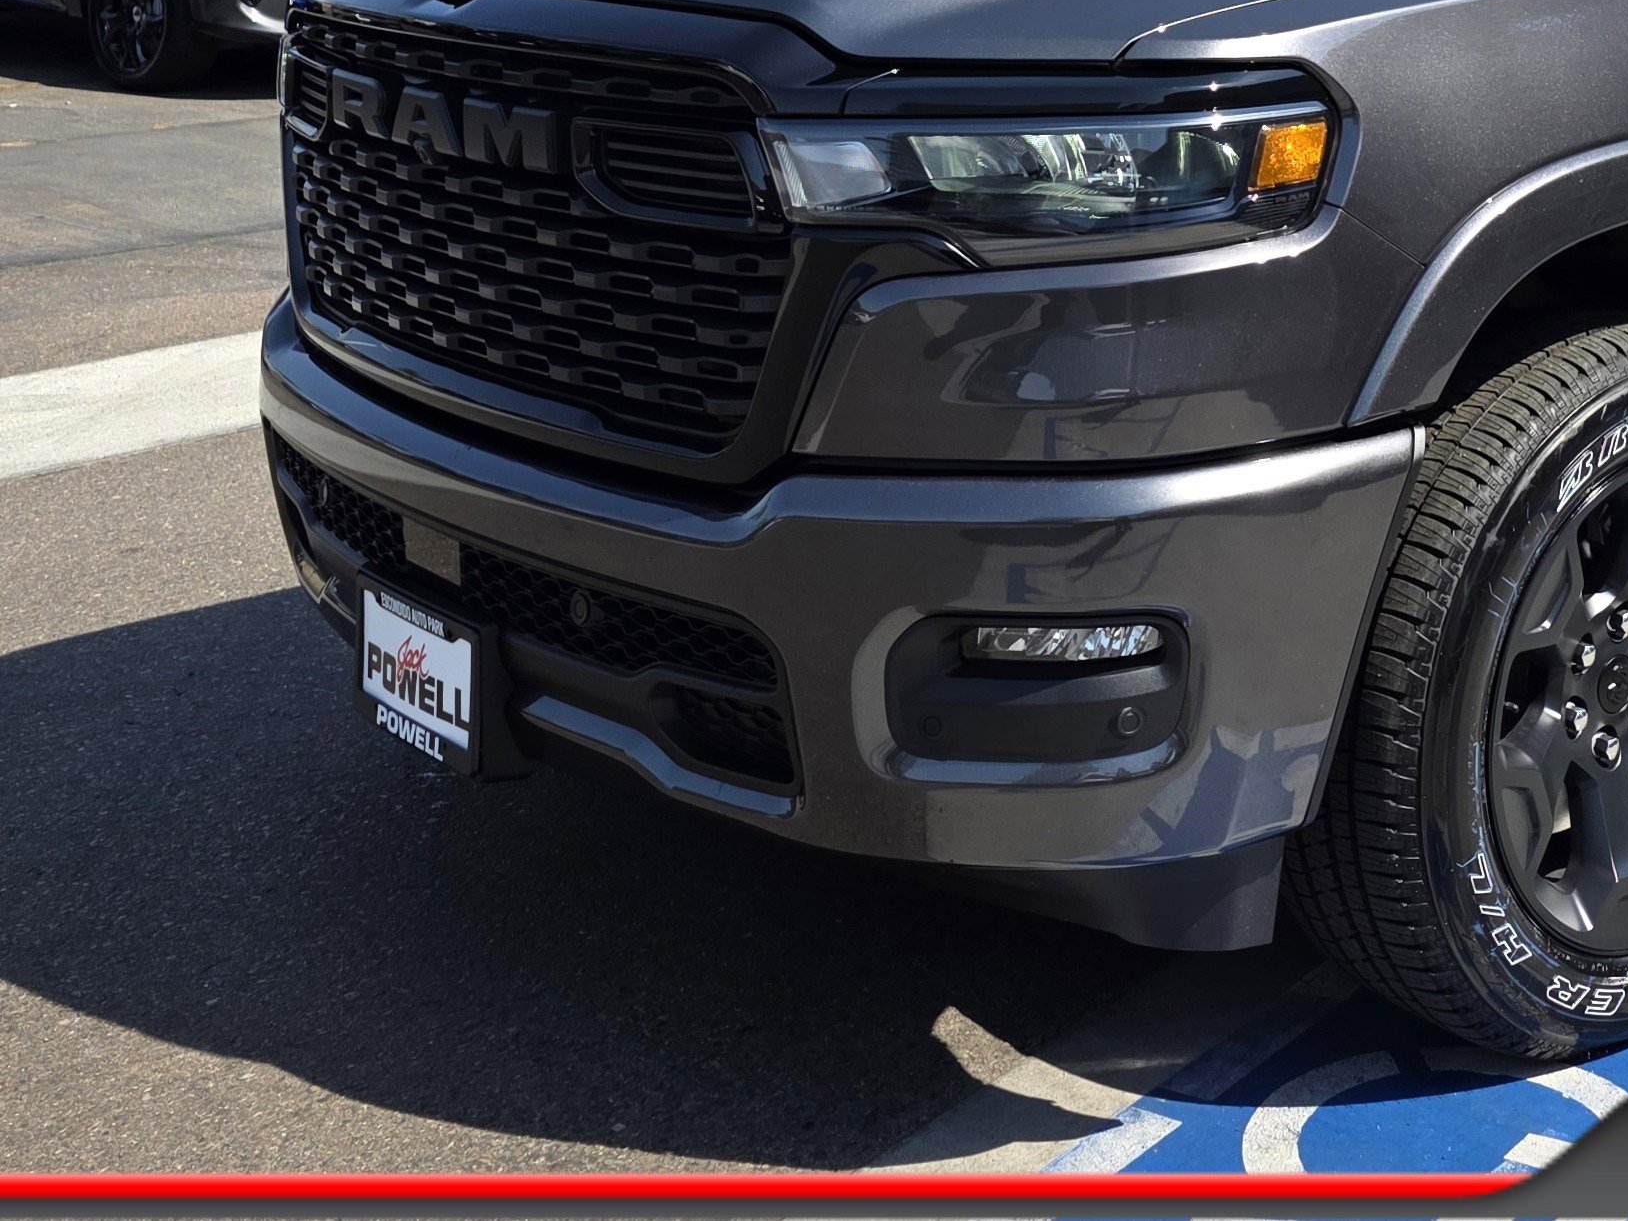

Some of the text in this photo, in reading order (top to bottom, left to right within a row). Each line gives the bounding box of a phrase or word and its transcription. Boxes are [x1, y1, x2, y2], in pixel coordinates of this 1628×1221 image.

[332, 67, 557, 175] RAM
[428, 615, 445, 638] PARK
[367, 641, 470, 728] POWELL
[397, 635, 429, 685] Jack
[376, 704, 444, 762] POWELL
